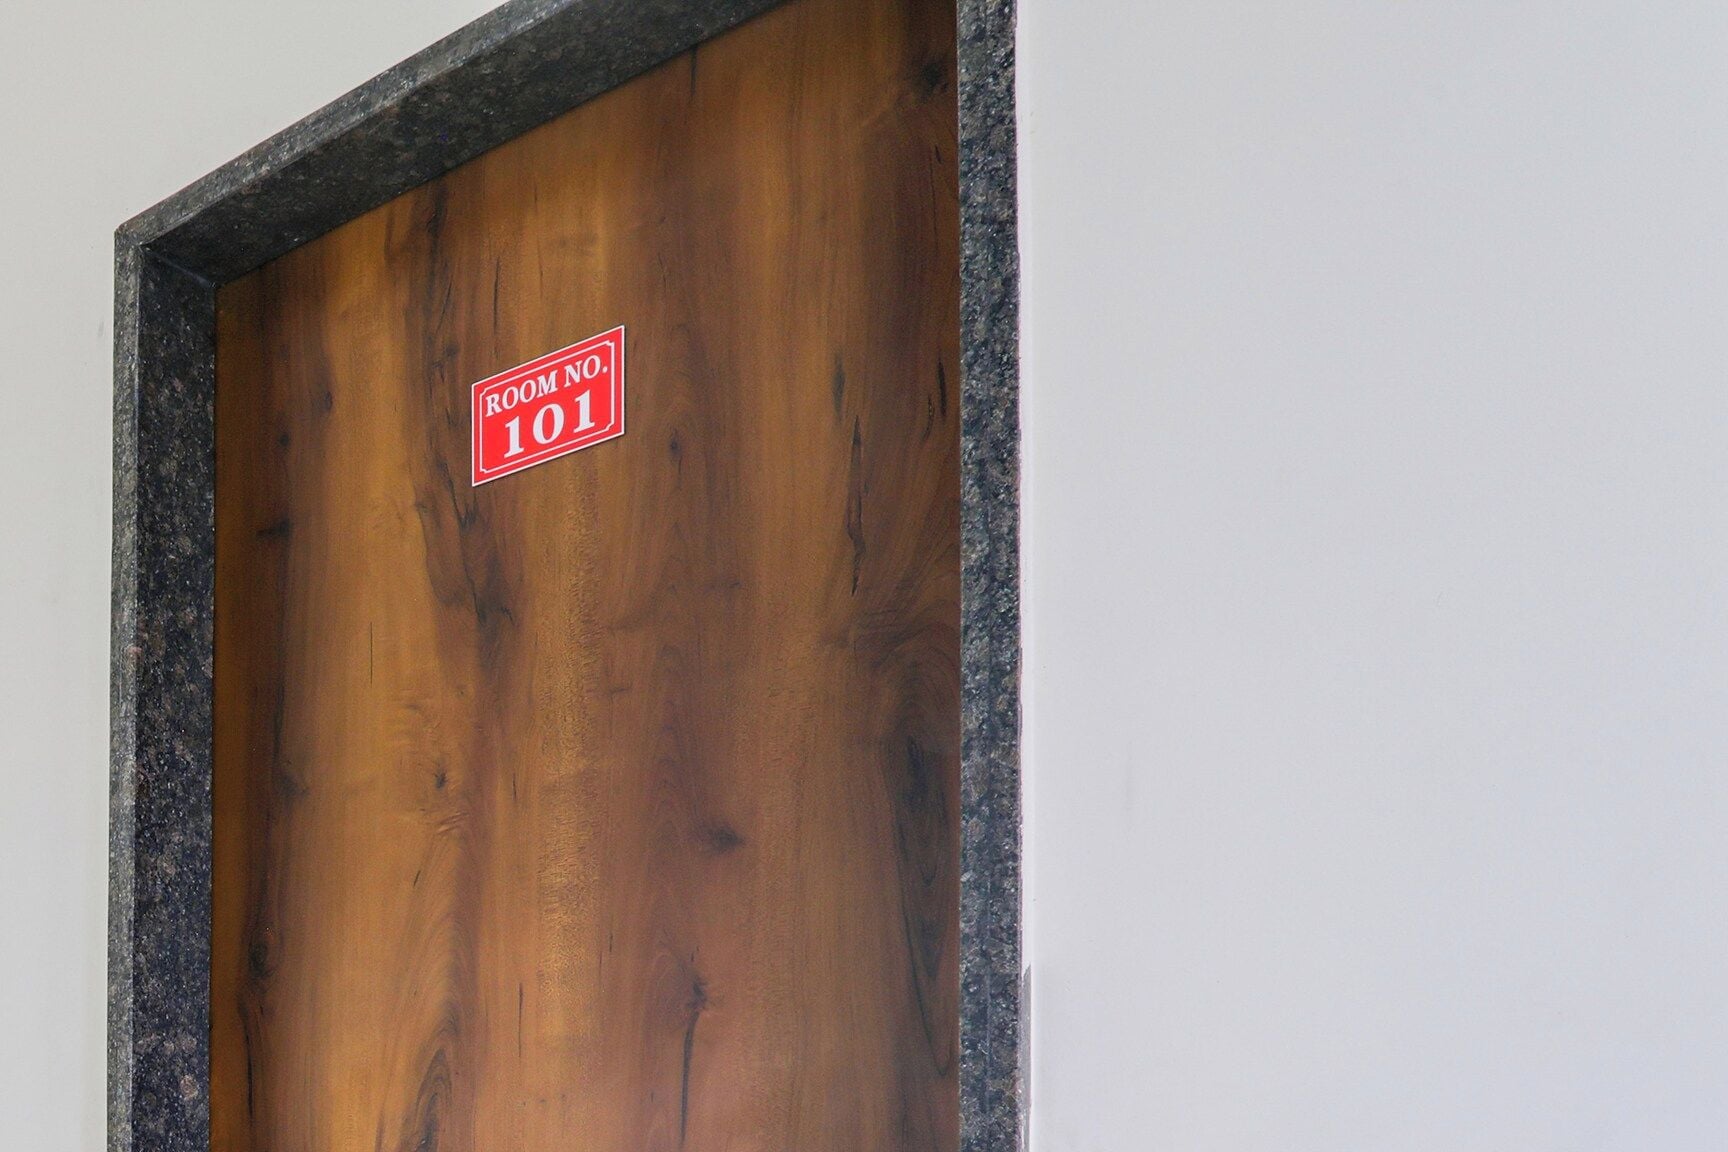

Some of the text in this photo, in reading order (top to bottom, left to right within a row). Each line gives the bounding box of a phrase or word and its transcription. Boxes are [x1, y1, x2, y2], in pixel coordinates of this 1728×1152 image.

[486, 354, 608, 417] ROOM NO.
[503, 389, 595, 458] 101
